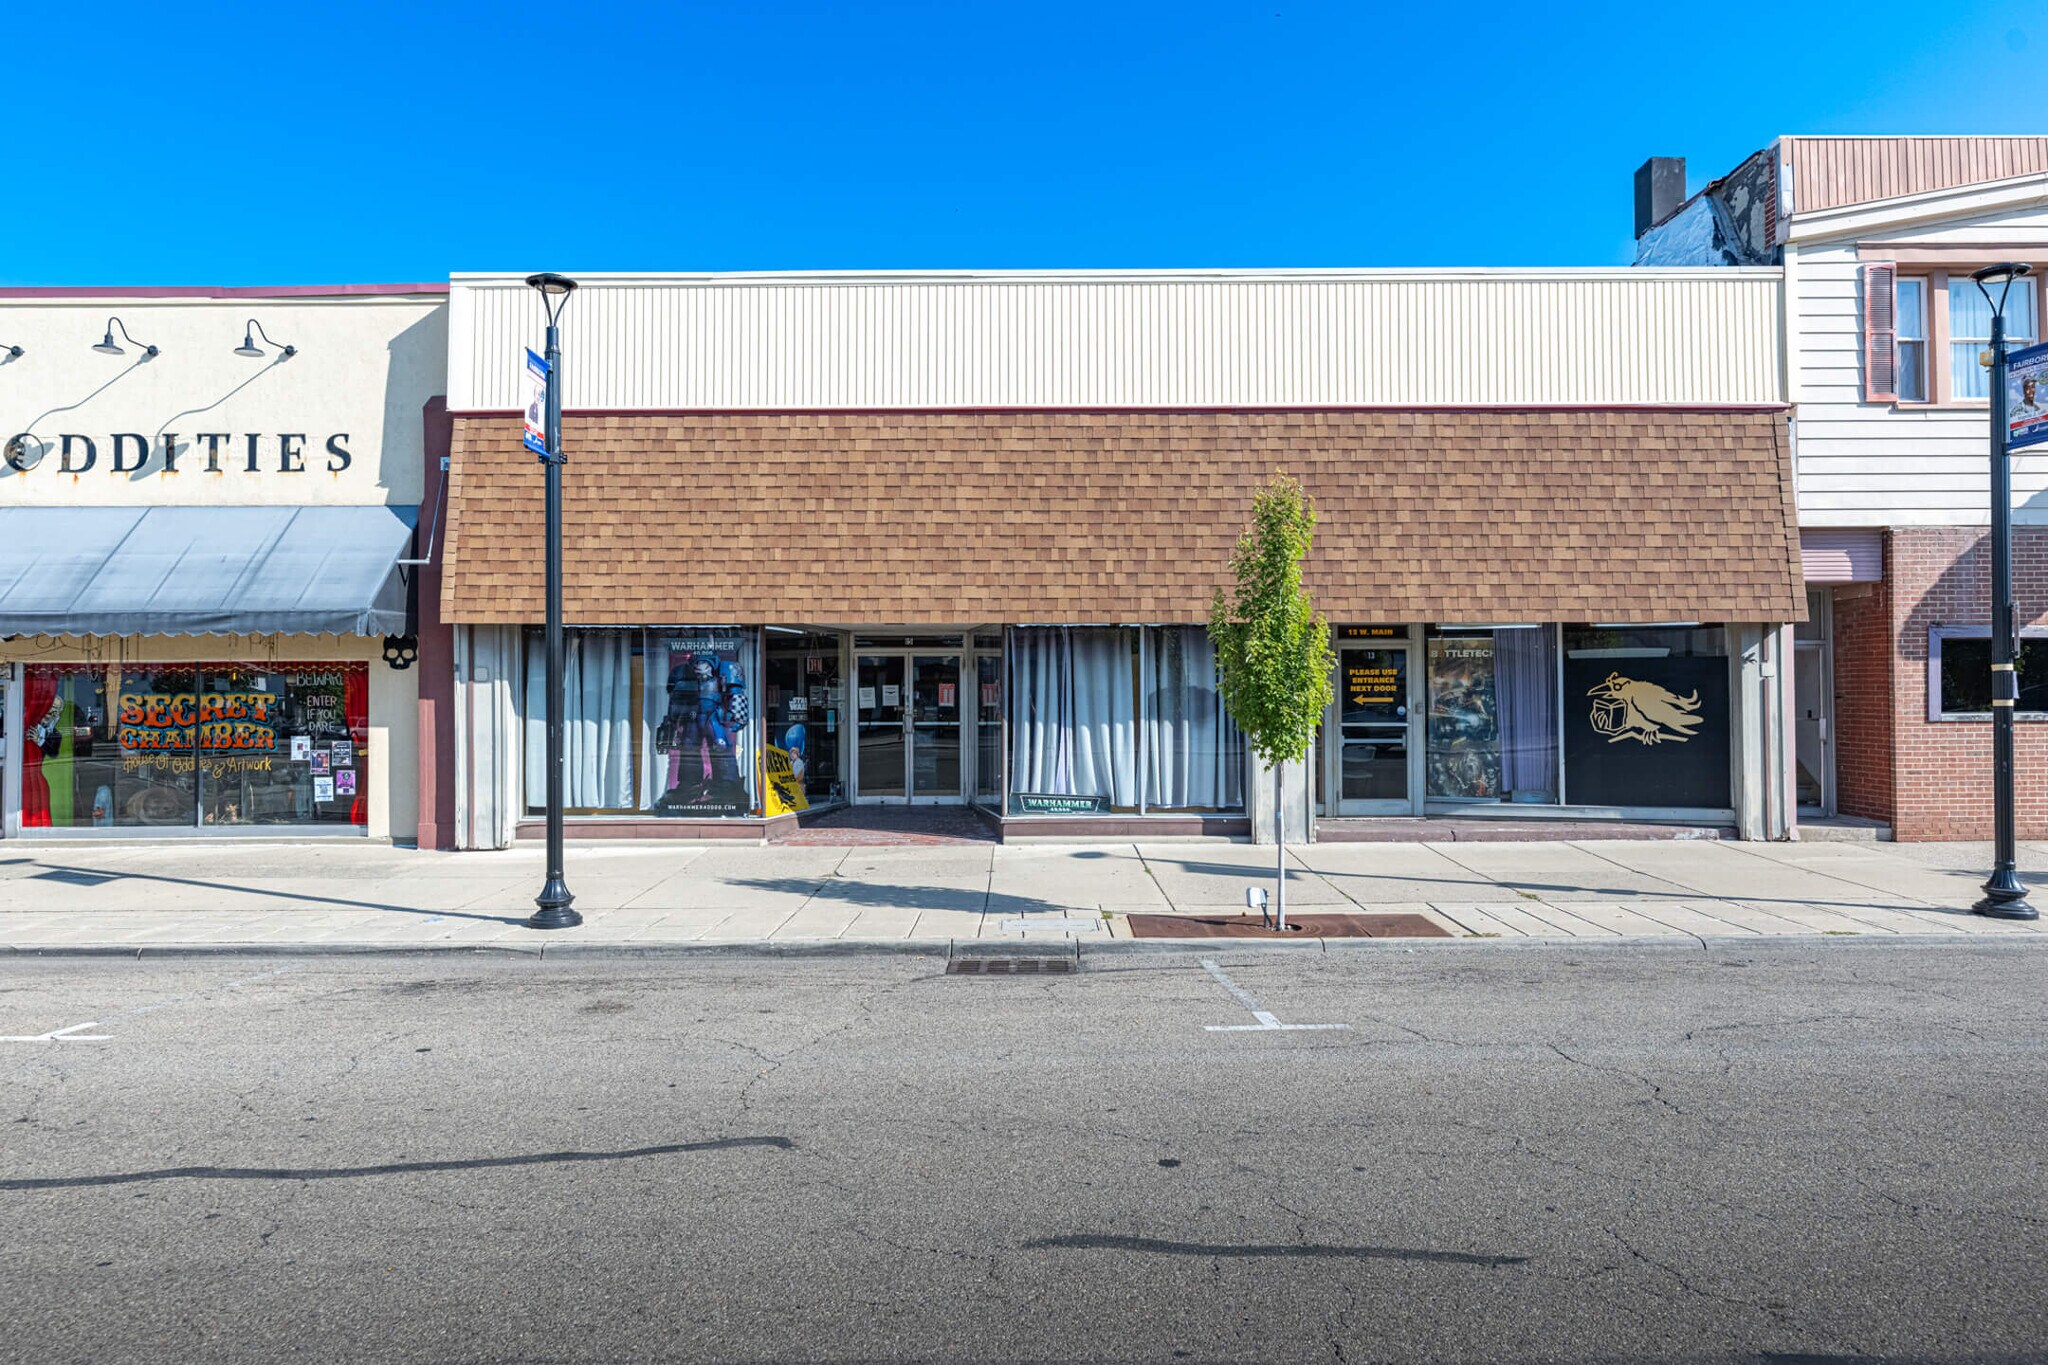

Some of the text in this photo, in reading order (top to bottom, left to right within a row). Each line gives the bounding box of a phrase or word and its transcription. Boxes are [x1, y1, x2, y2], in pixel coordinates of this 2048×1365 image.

[3, 432, 352, 473] ODDITIES
[1371, 628, 1393, 636] MAIN
[671, 641, 734, 651] WARHAMMER
[307, 695, 337, 706] ENTER
[119, 692, 276, 728] SECRET
[307, 708, 336, 720] IF YOU
[308, 721, 336, 732] DARE
[119, 721, 277, 750] CHAMBER
[123, 753, 155, 774] House
[172, 754, 212, 774] Oddies
[226, 754, 272, 774] Artwork
[1027, 798, 1092, 809] WARHAMMER
